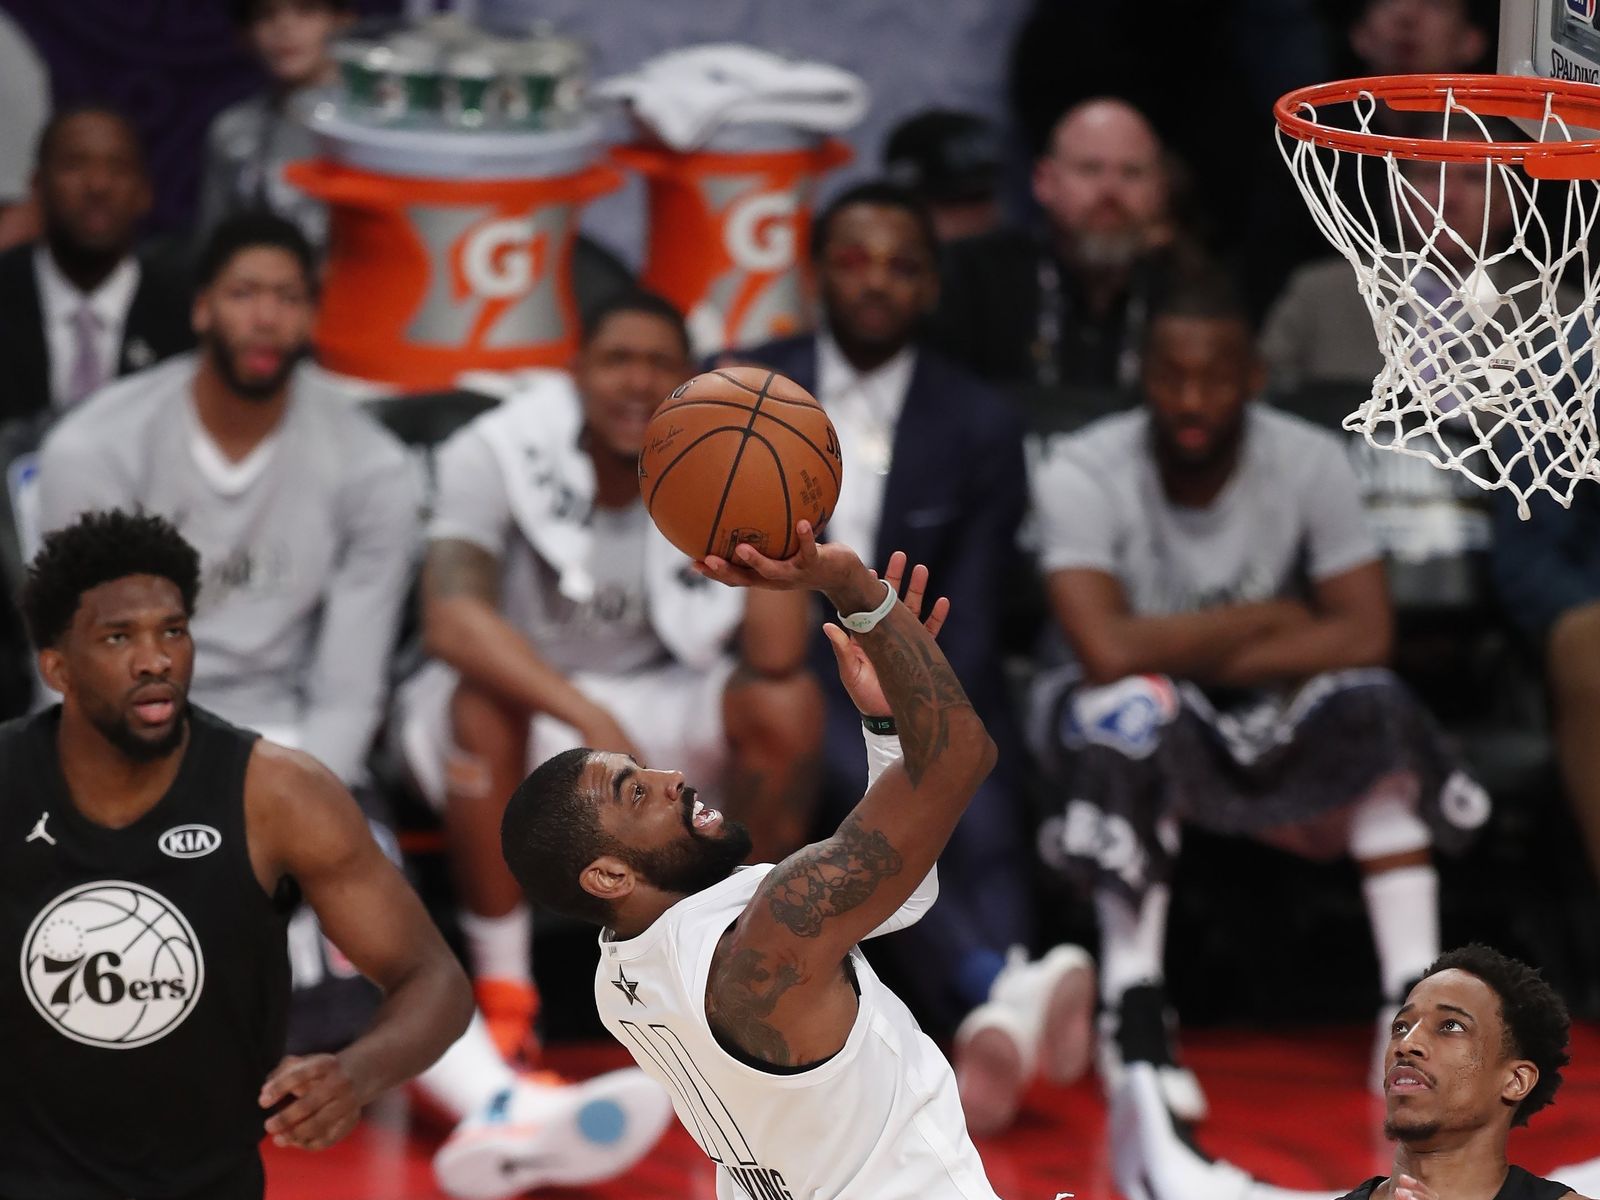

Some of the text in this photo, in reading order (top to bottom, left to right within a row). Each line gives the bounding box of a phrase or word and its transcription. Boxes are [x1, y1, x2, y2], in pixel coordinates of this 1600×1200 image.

[463, 218, 534, 298] G
[168, 831, 211, 852] KIA
[43, 951, 187, 1006] 76ers
